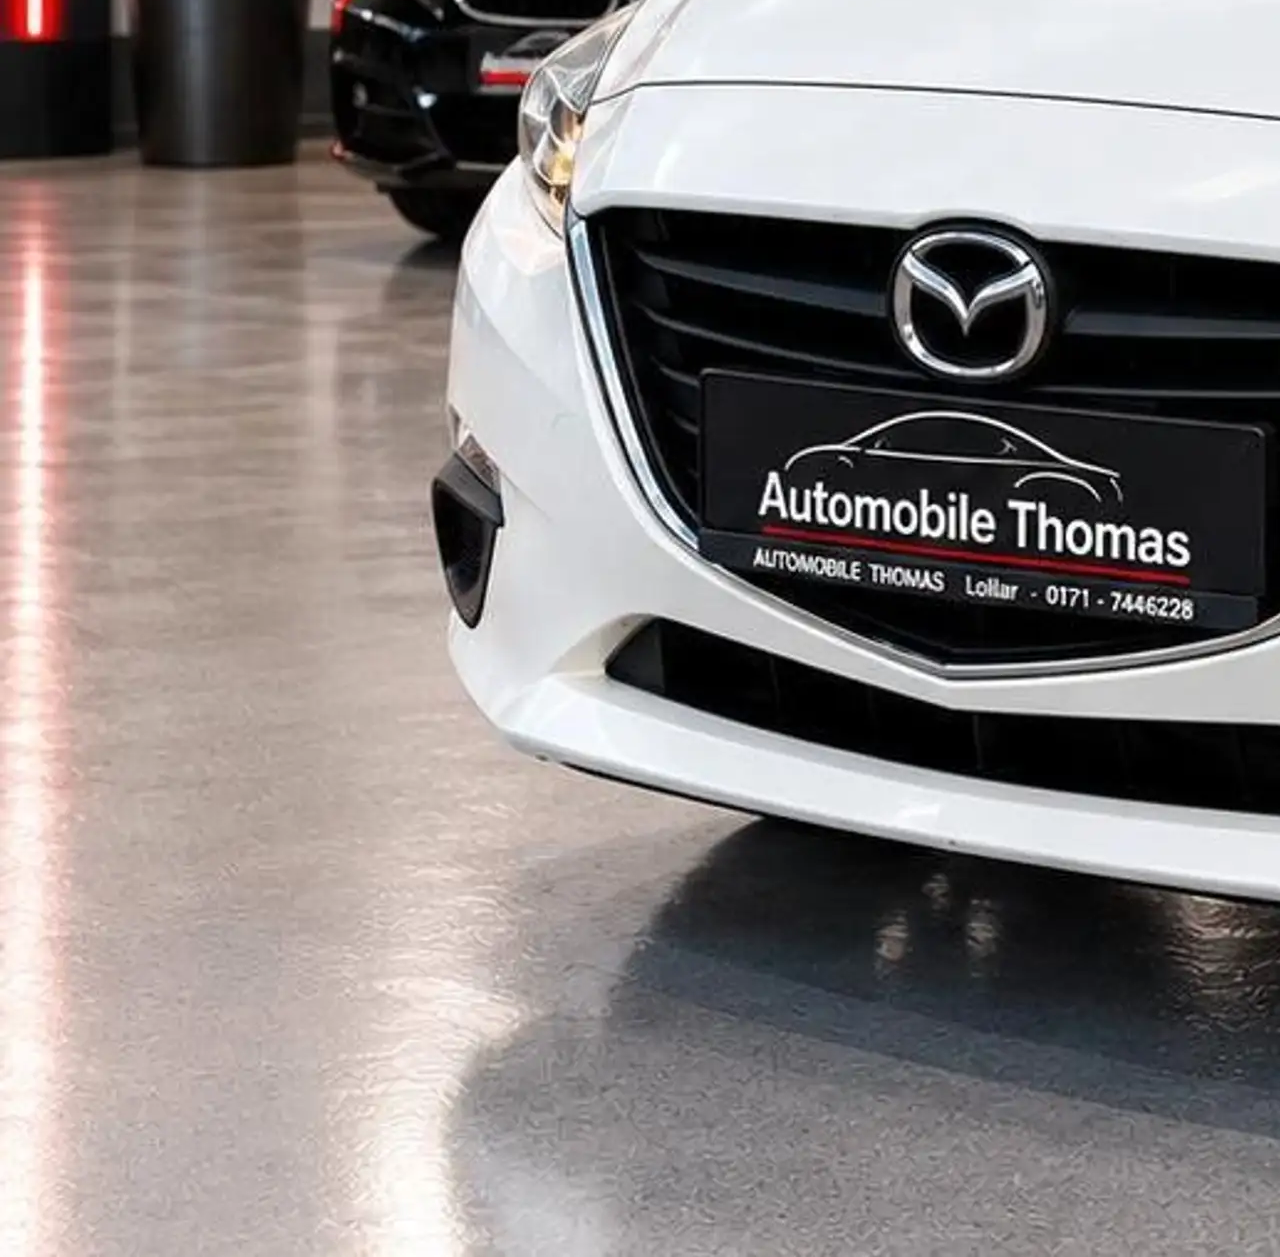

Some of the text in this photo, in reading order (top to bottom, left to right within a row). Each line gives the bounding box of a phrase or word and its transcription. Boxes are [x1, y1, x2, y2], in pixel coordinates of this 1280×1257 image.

[758, 471, 1191, 567] Automobile Thomas
[753, 547, 861, 581] AUTOMOBILE
[868, 563, 945, 592] THOMAS
[1045, 585, 1089, 607] 0171
[1110, 591, 1194, 620] 7446228
